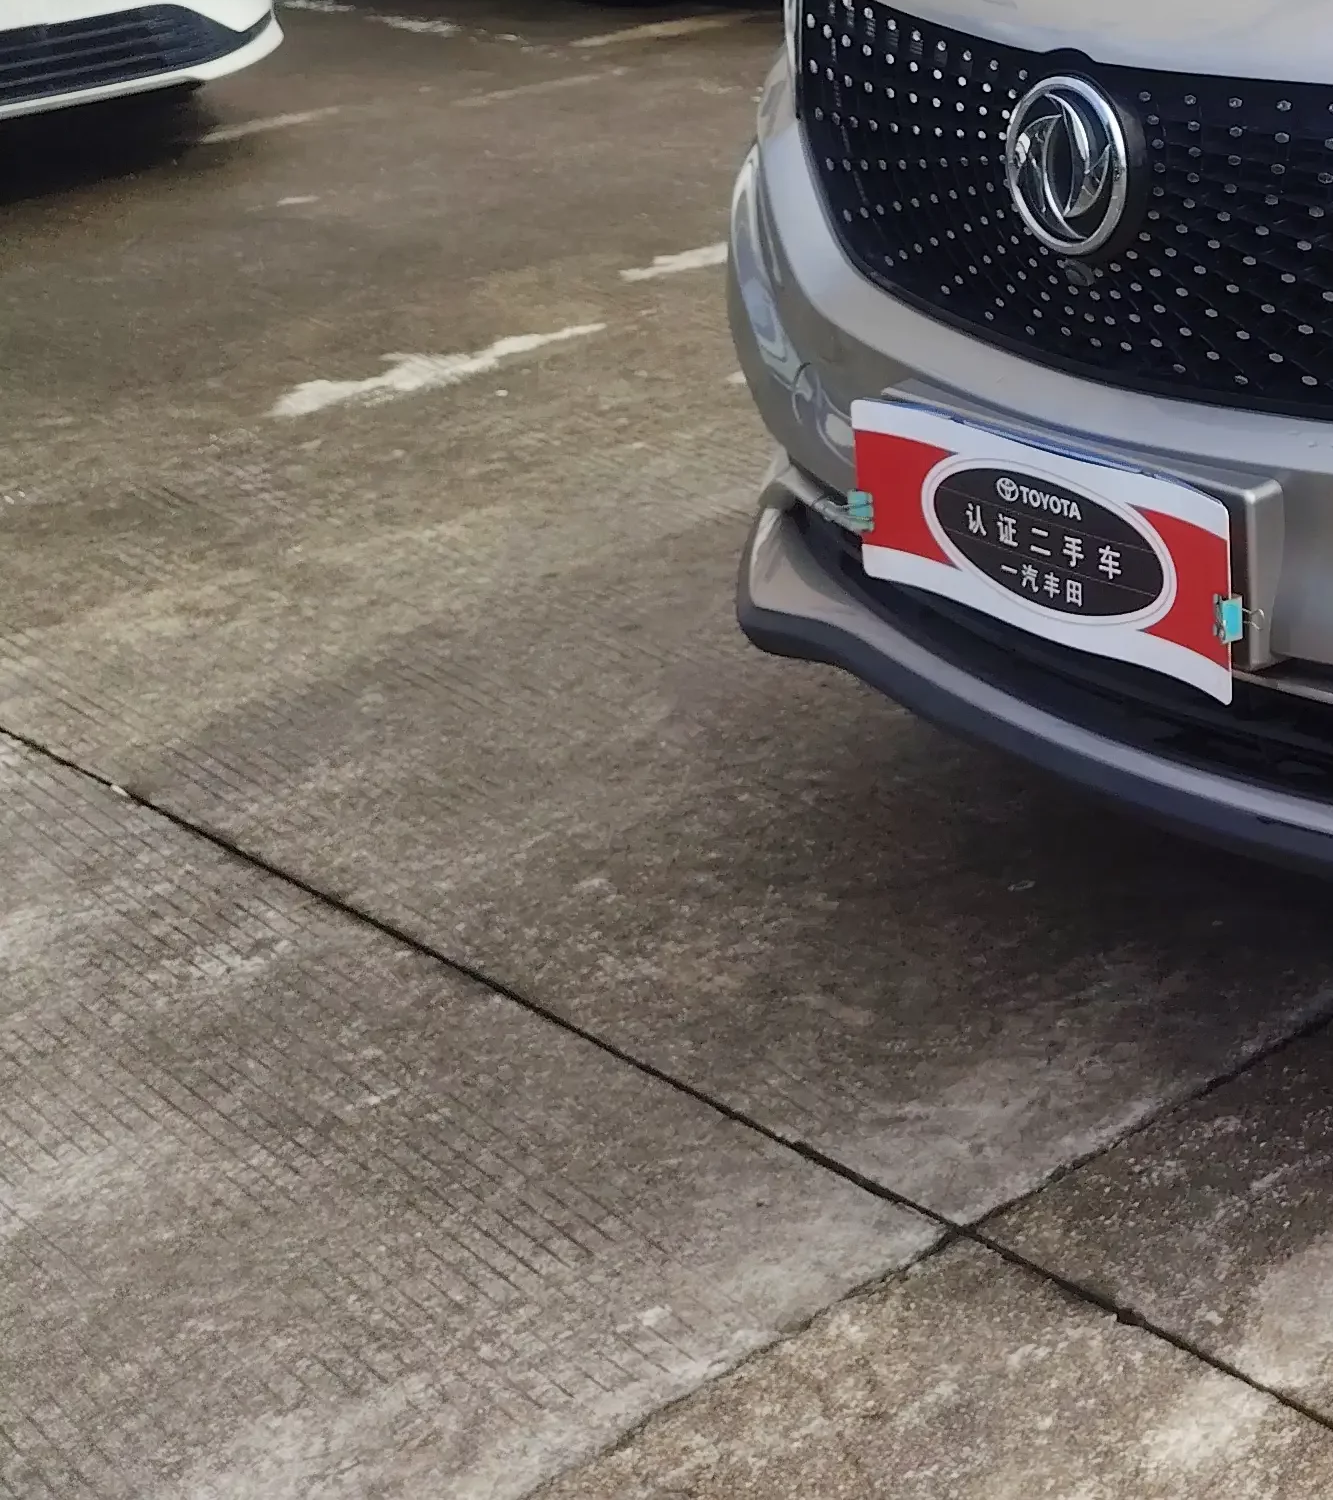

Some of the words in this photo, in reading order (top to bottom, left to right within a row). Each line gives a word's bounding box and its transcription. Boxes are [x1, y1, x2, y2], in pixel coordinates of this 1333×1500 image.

[1019, 485, 1082, 521] TOYOTA
[965, 503, 1122, 580] 认证二手车
[1000, 563, 1084, 607] 一汽丰田
